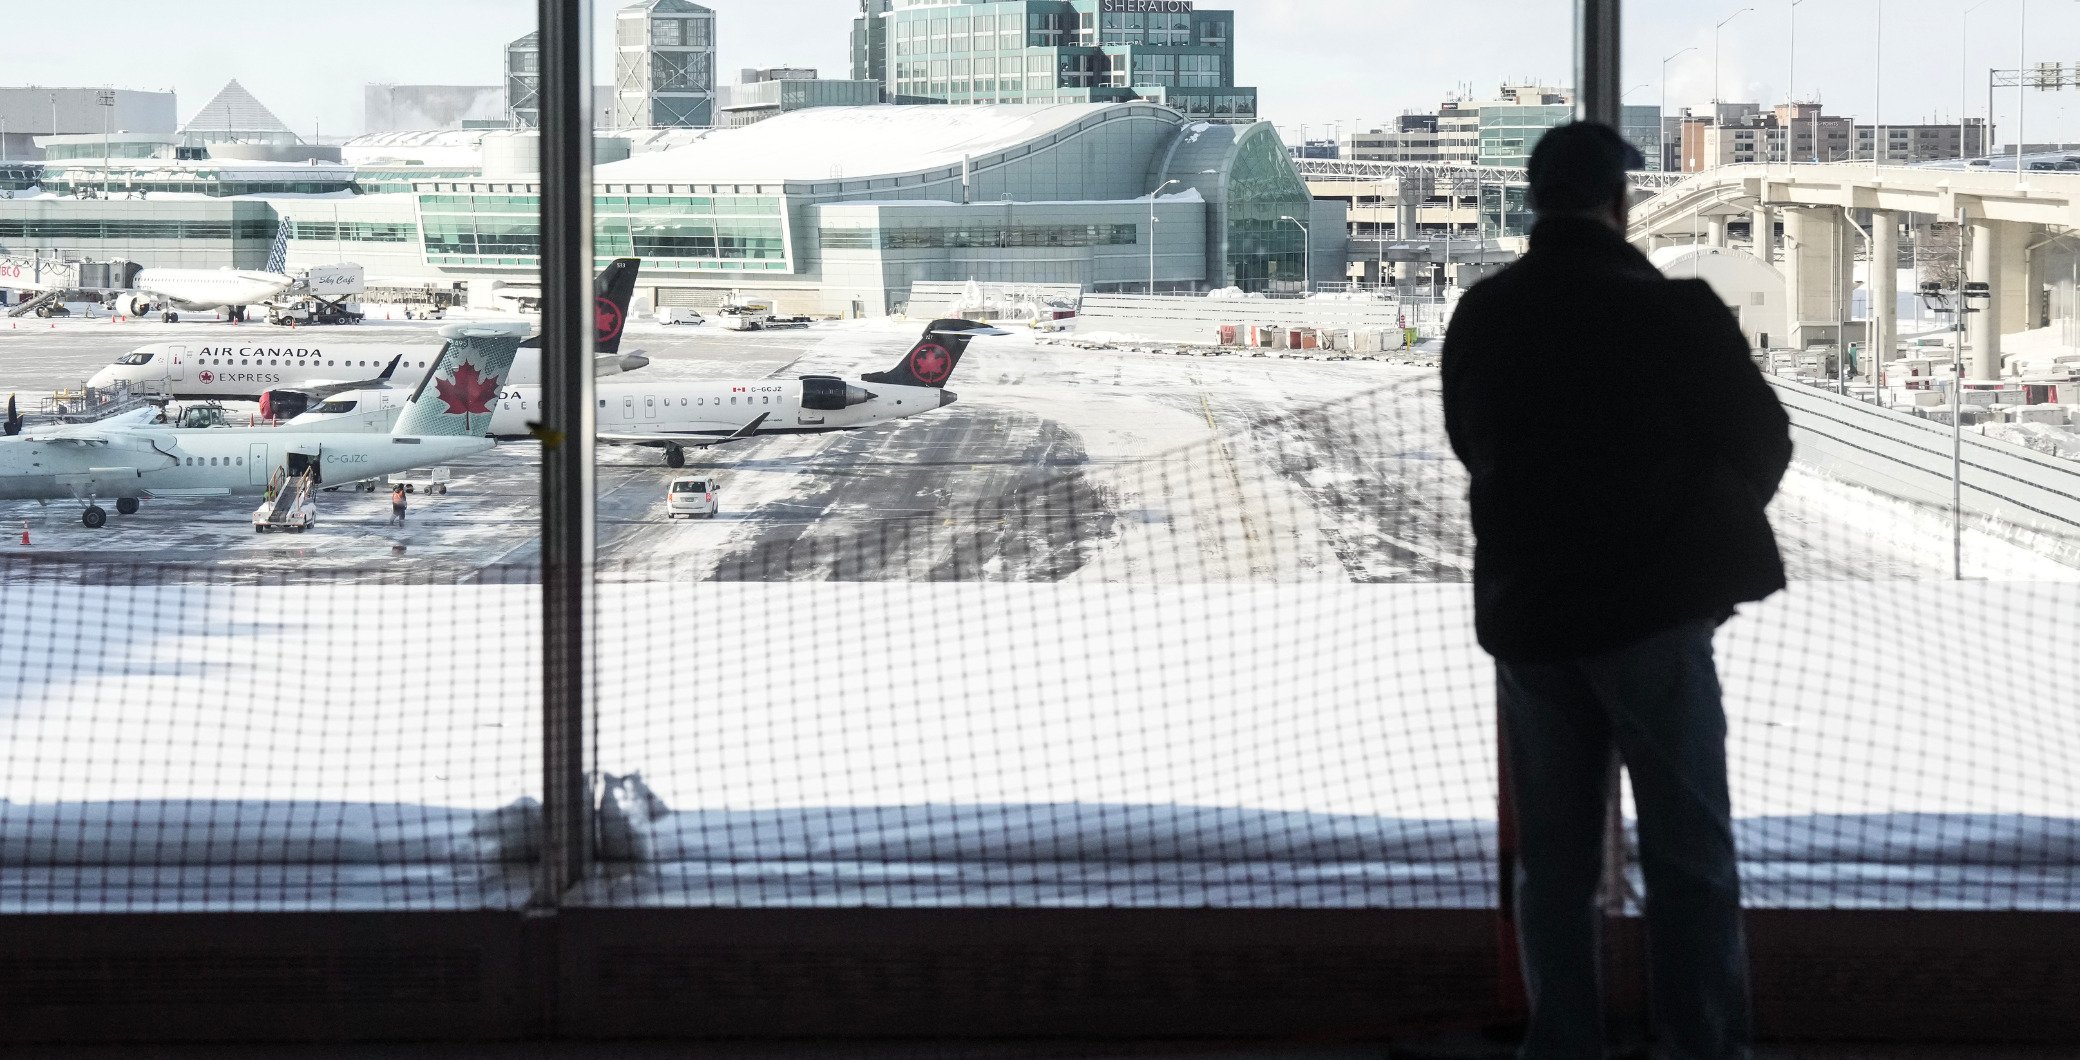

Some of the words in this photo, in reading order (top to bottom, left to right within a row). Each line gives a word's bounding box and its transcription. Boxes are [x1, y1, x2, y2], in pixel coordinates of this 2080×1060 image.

[1104, 0, 1192, 12] SHERATON
[319, 275, 335, 285] Sky
[336, 275, 356, 285] Café
[199, 347, 233, 356] AIR
[239, 347, 322, 358] CANADA
[219, 373, 280, 383] EXPRESS
[326, 454, 368, 464] C-GJZC
